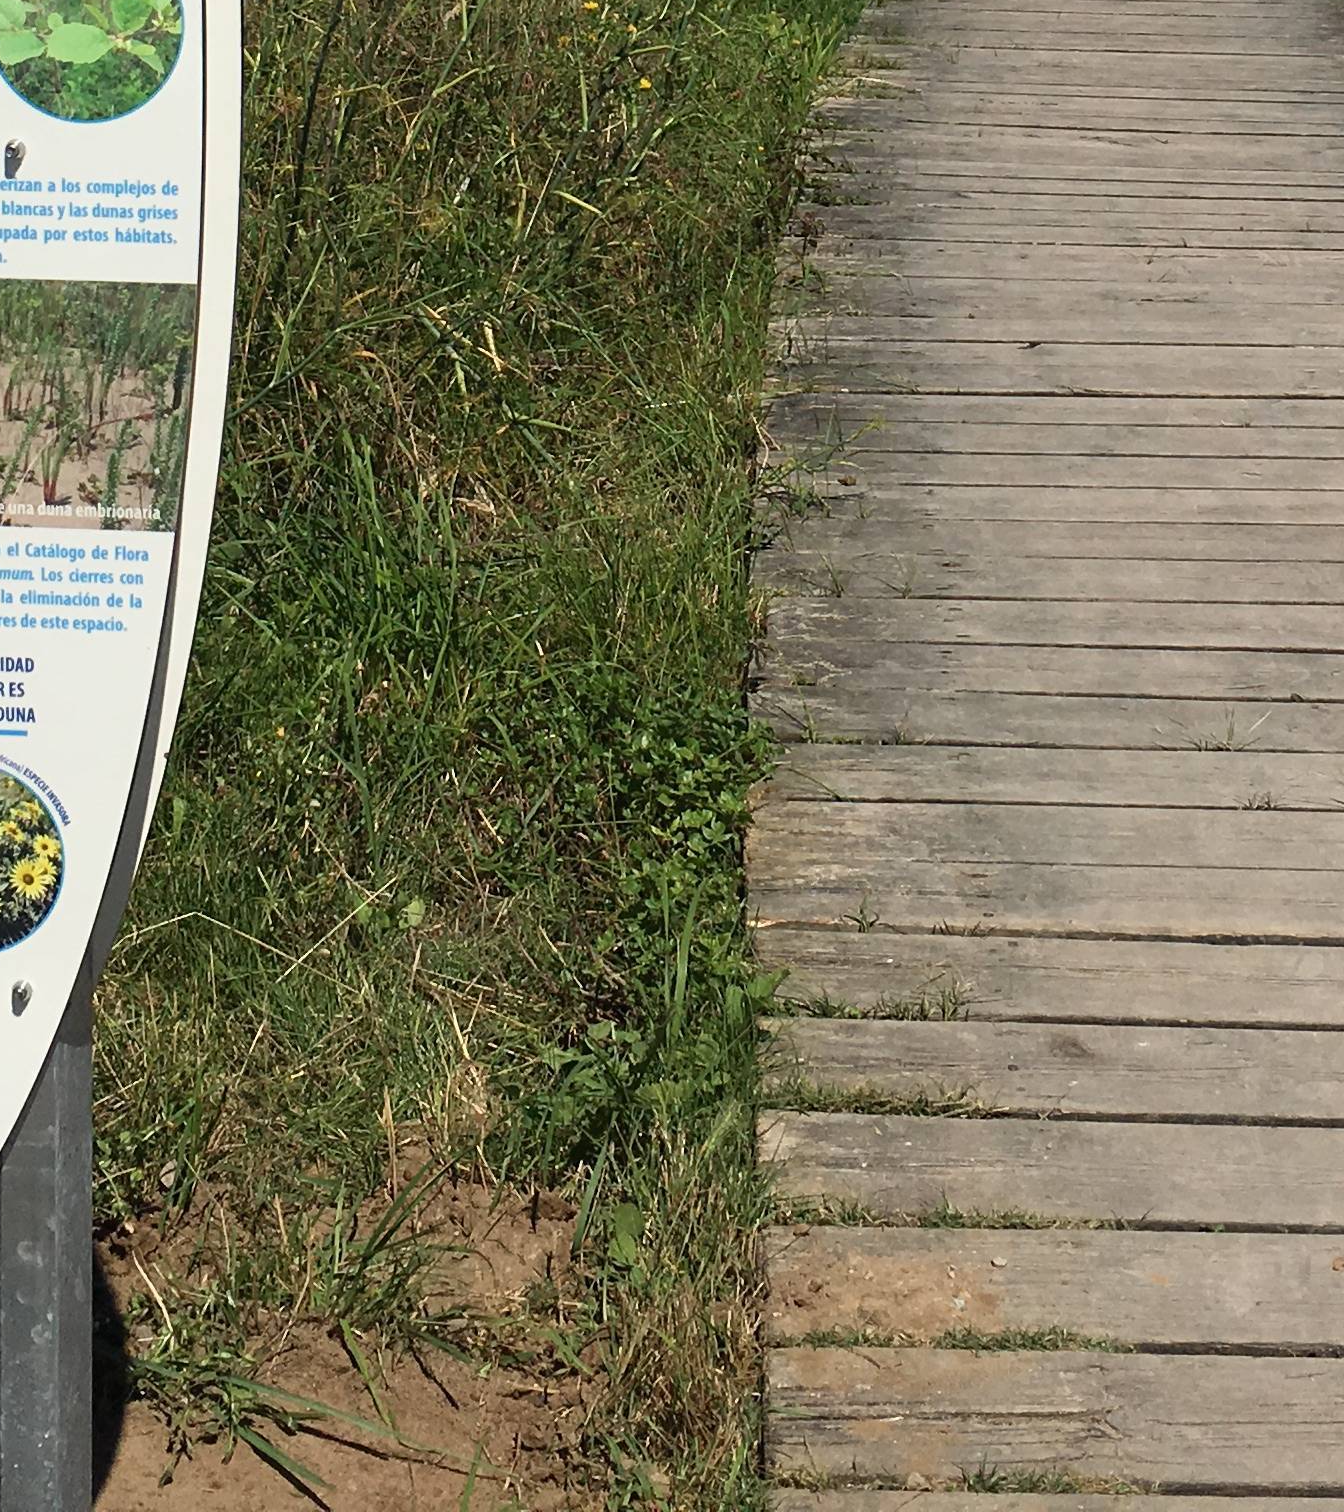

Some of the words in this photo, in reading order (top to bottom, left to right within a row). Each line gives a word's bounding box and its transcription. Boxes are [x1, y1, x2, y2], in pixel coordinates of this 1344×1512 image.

[8, 501, 34, 516] una
[36, 500, 72, 518] duna
[75, 502, 162, 522] embrionaria
